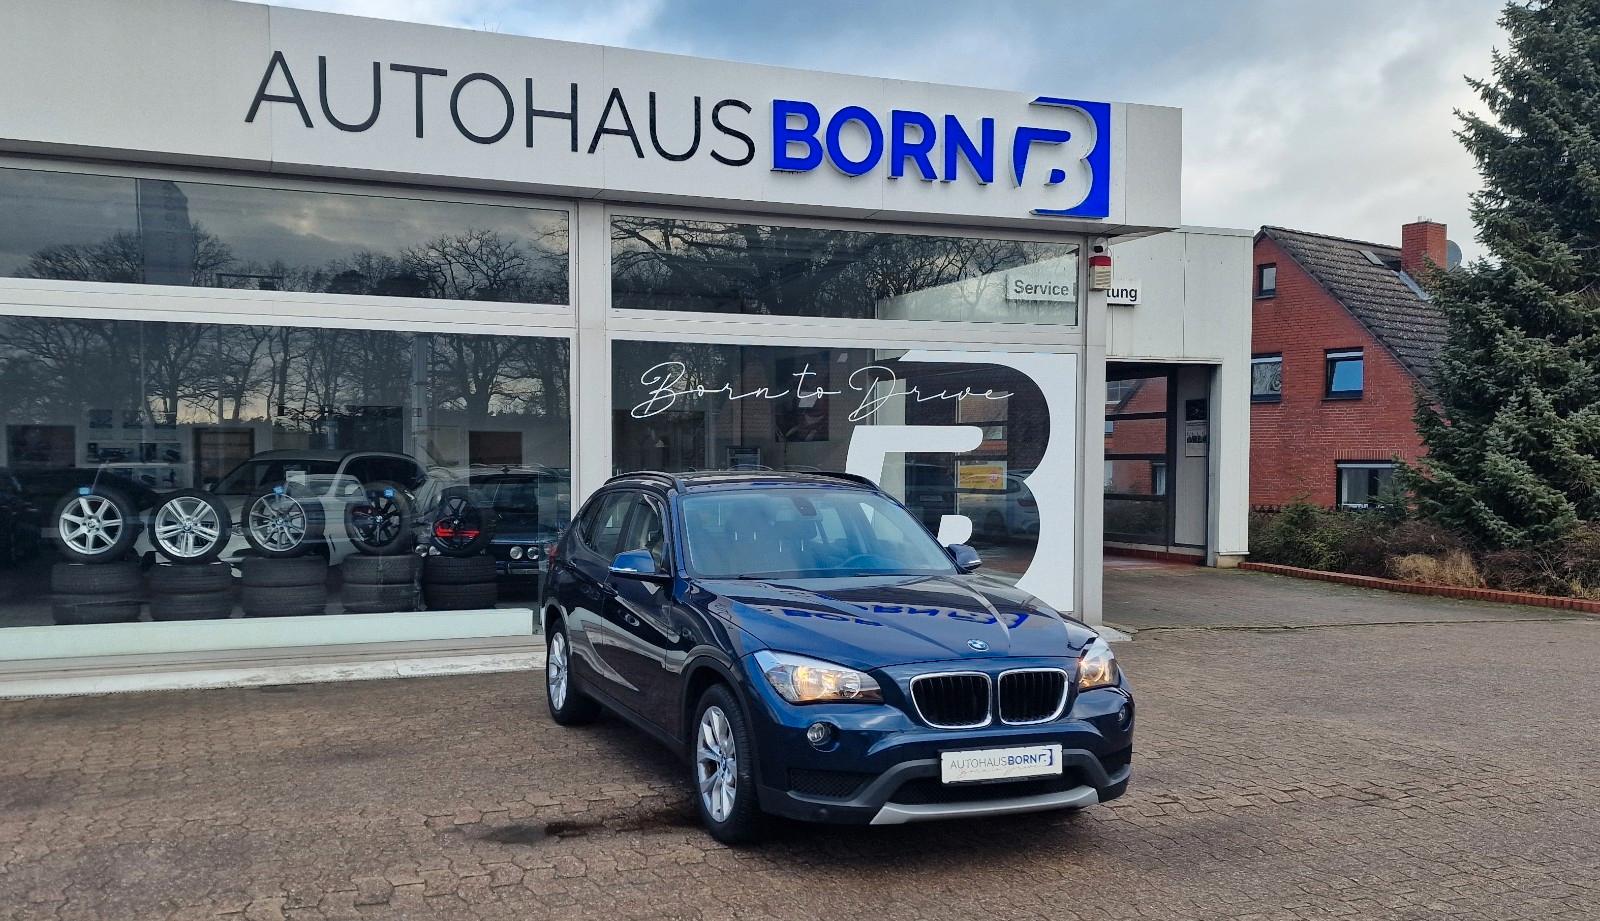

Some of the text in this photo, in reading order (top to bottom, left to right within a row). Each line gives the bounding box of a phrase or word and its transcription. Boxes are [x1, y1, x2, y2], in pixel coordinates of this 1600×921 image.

[1014, 279, 1069, 296] Service
[630, 361, 1015, 422] Born to Drive
